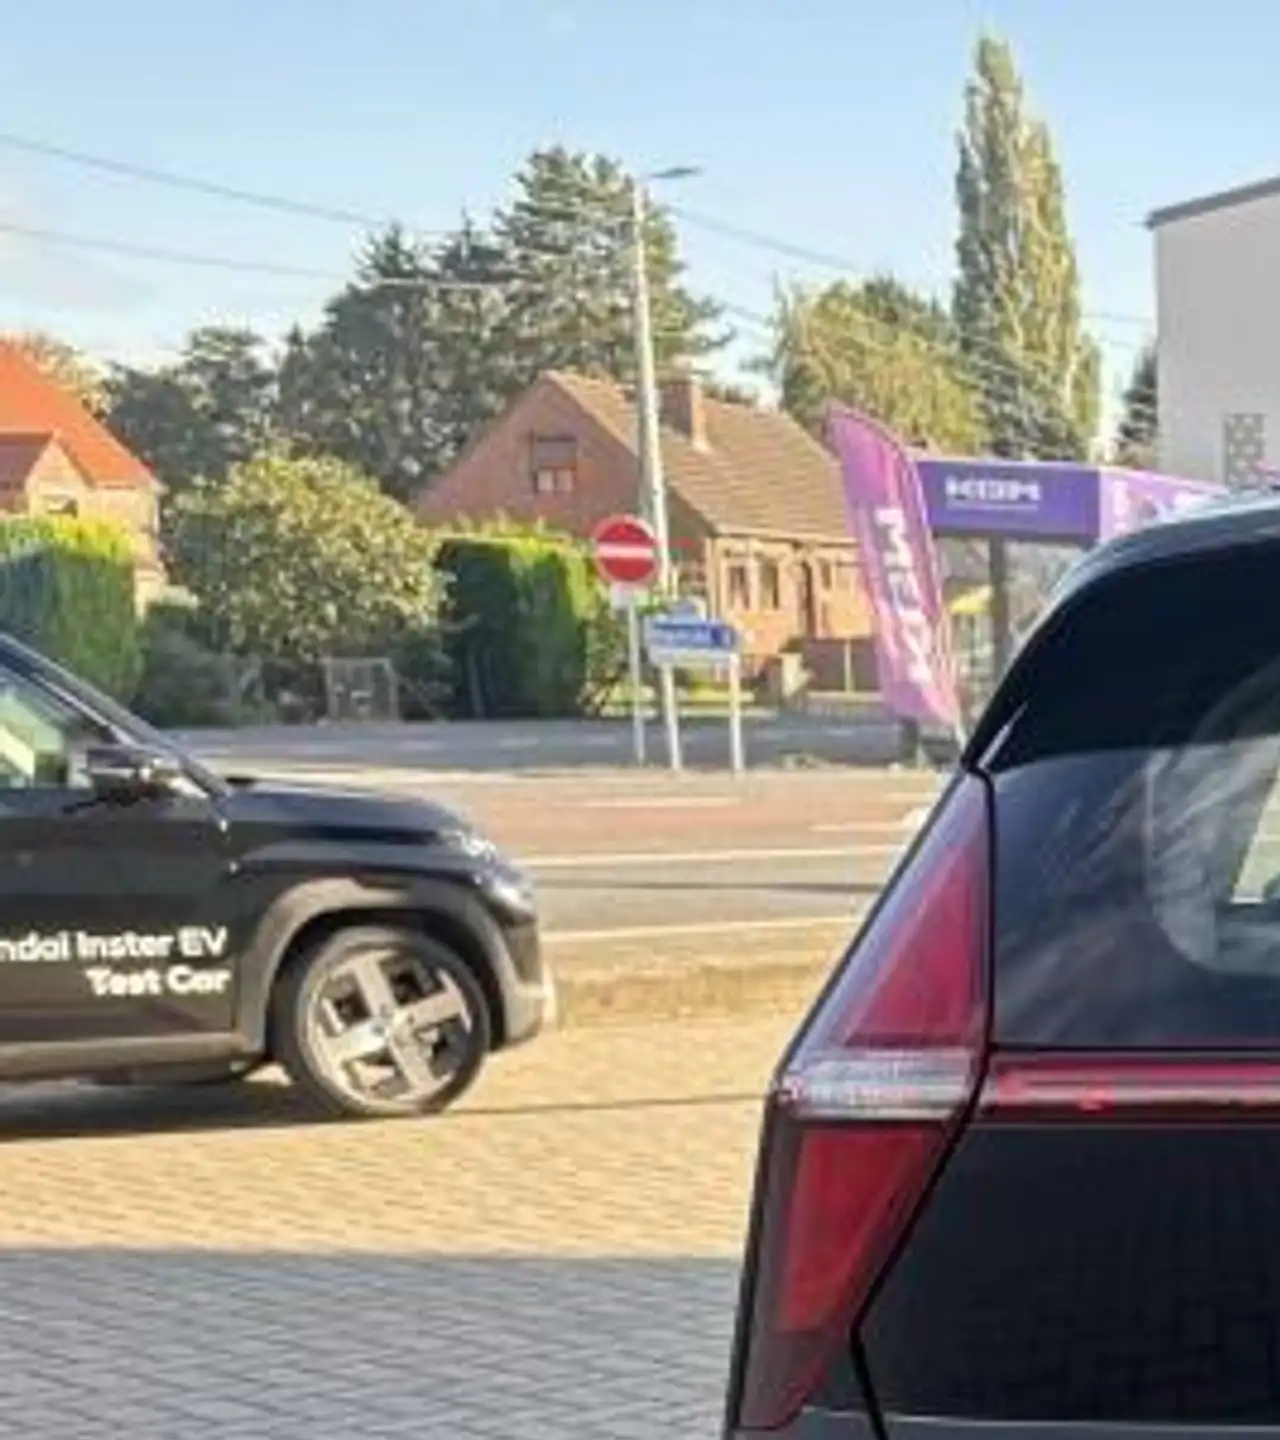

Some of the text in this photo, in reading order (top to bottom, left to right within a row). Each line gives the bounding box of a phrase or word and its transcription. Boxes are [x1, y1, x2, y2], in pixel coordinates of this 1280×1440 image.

[76, 930, 175, 960] Inster
[178, 925, 228, 958] EV
[85, 963, 232, 996] Test Car
